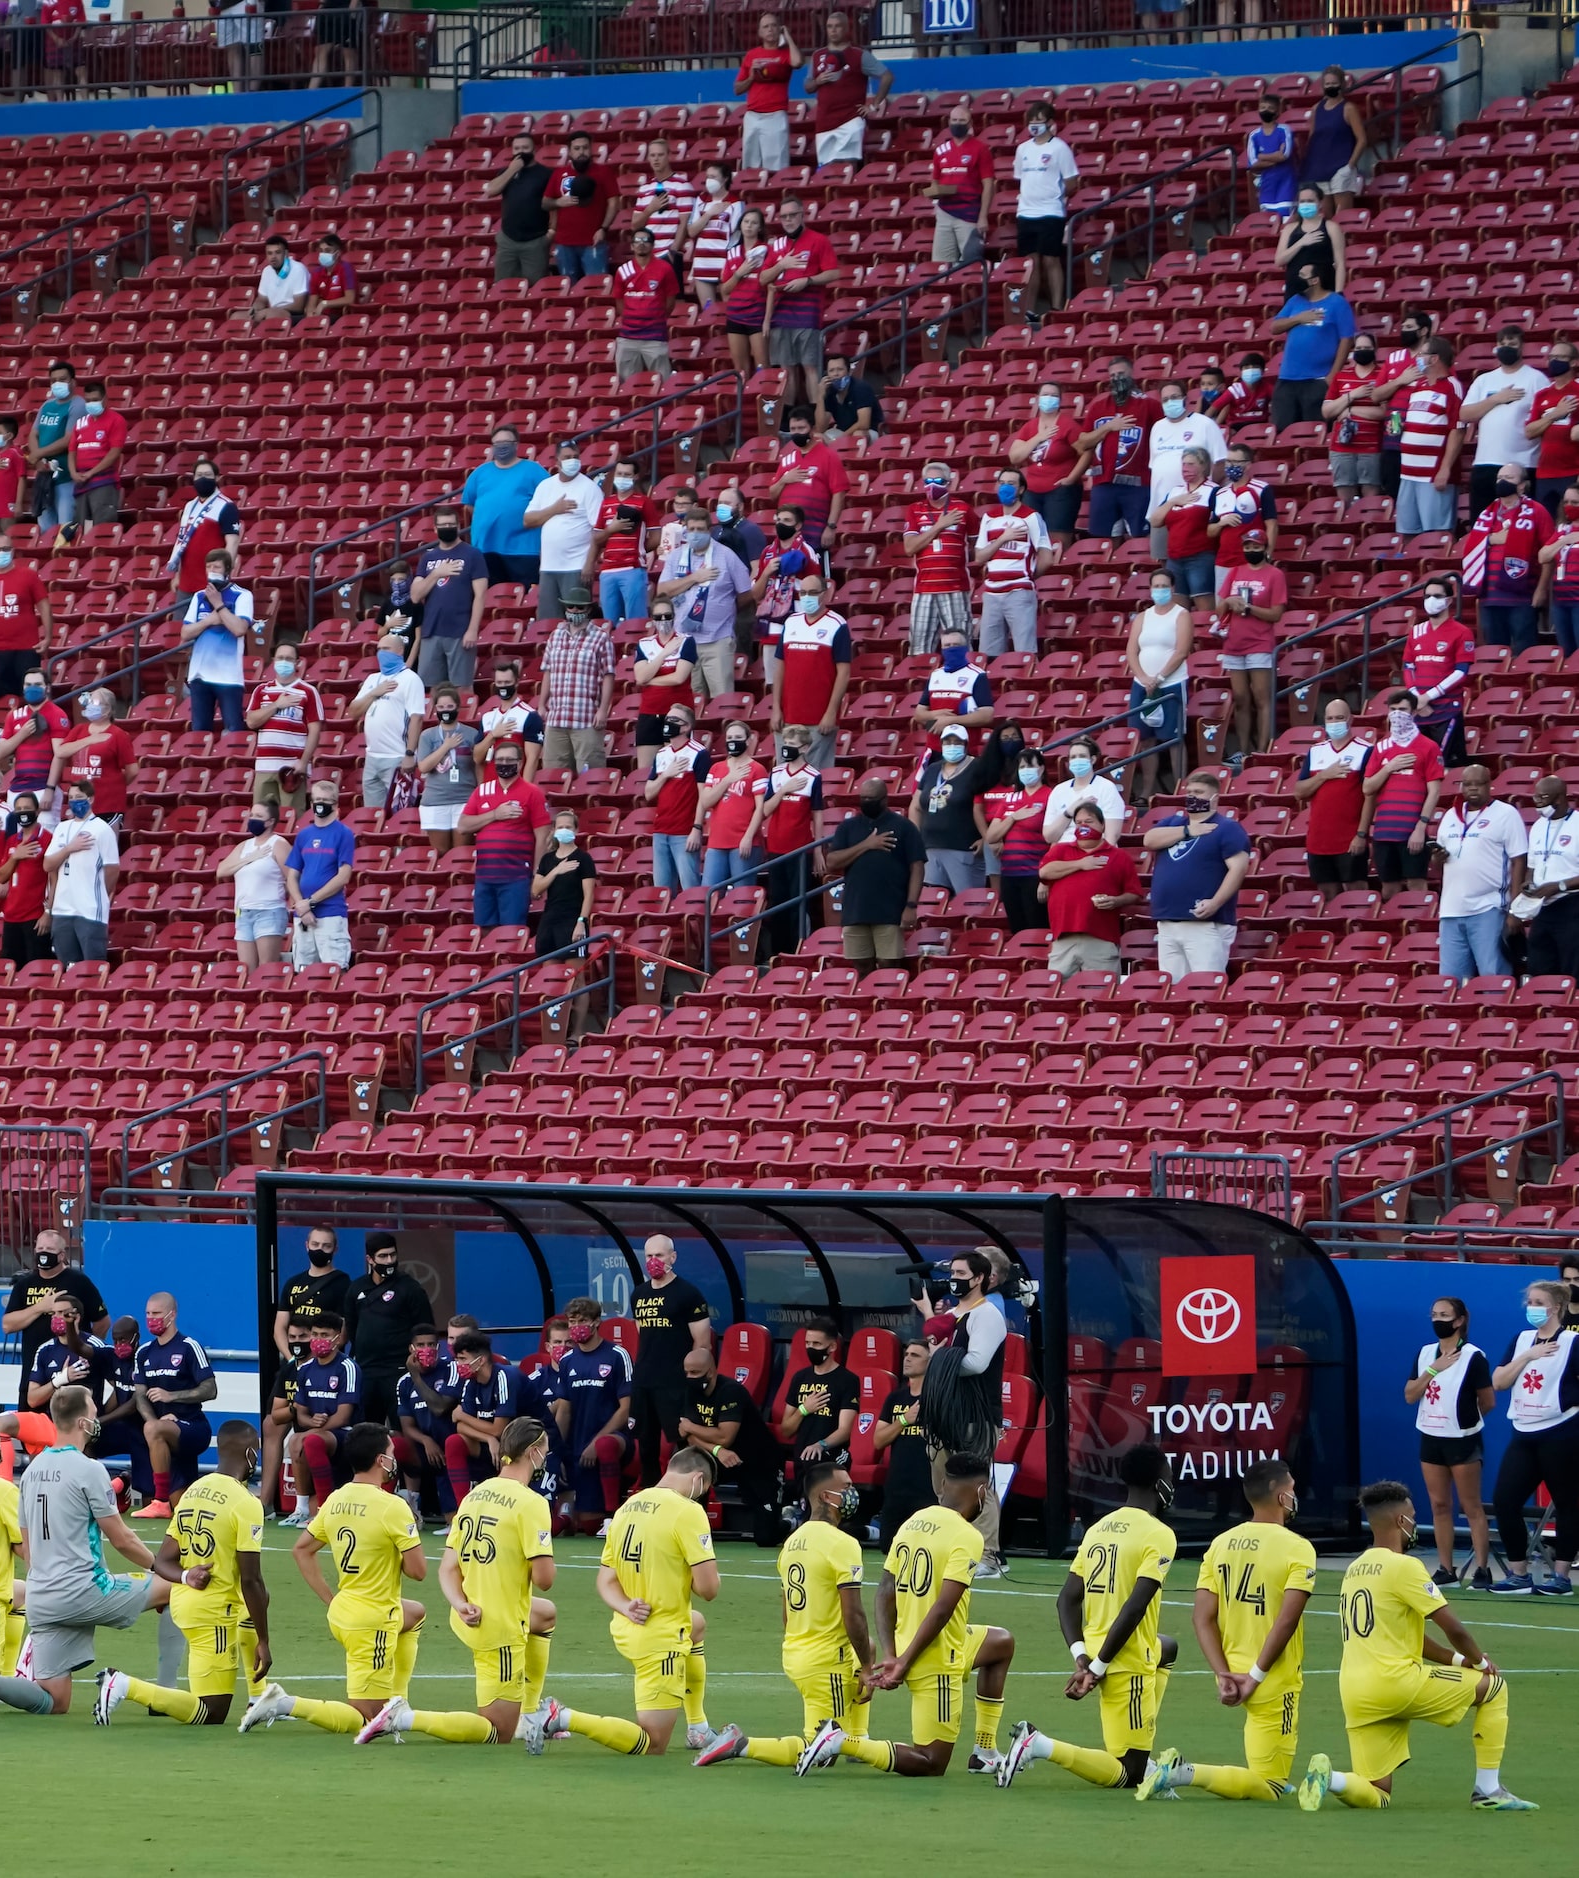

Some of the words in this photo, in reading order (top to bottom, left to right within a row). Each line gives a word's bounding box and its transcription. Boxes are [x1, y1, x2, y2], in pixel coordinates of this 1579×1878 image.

[929, 0, 969, 28] 110
[27, 1286, 57, 1297] BLACK
[292, 1286, 309, 1295] BLA
[636, 1296, 666, 1309] BLACK
[635, 1308, 659, 1318] LIVES
[799, 1383, 829, 1393] BLACK
[892, 1404, 910, 1414] BLA
[1147, 1402, 1275, 1435] TOYOTA
[30, 1470, 61, 1483] WILLIS
[540, 1471, 558, 1492] 16
[36, 1493, 50, 1541] 1
[329, 1503, 367, 1517] LOVITZ
[176, 1508, 216, 1559] 55
[459, 1515, 499, 1565] 25
[905, 1519, 941, 1536] GODOY
[337, 1526, 360, 1574] 2
[621, 1524, 643, 1573] 4
[788, 1538, 807, 1552] LEAL
[895, 1542, 933, 1597] 20
[1086, 1543, 1119, 1594] 21
[787, 1561, 807, 1612] 8
[1218, 1562, 1266, 1617] 14
[1339, 1587, 1376, 1643] 10
